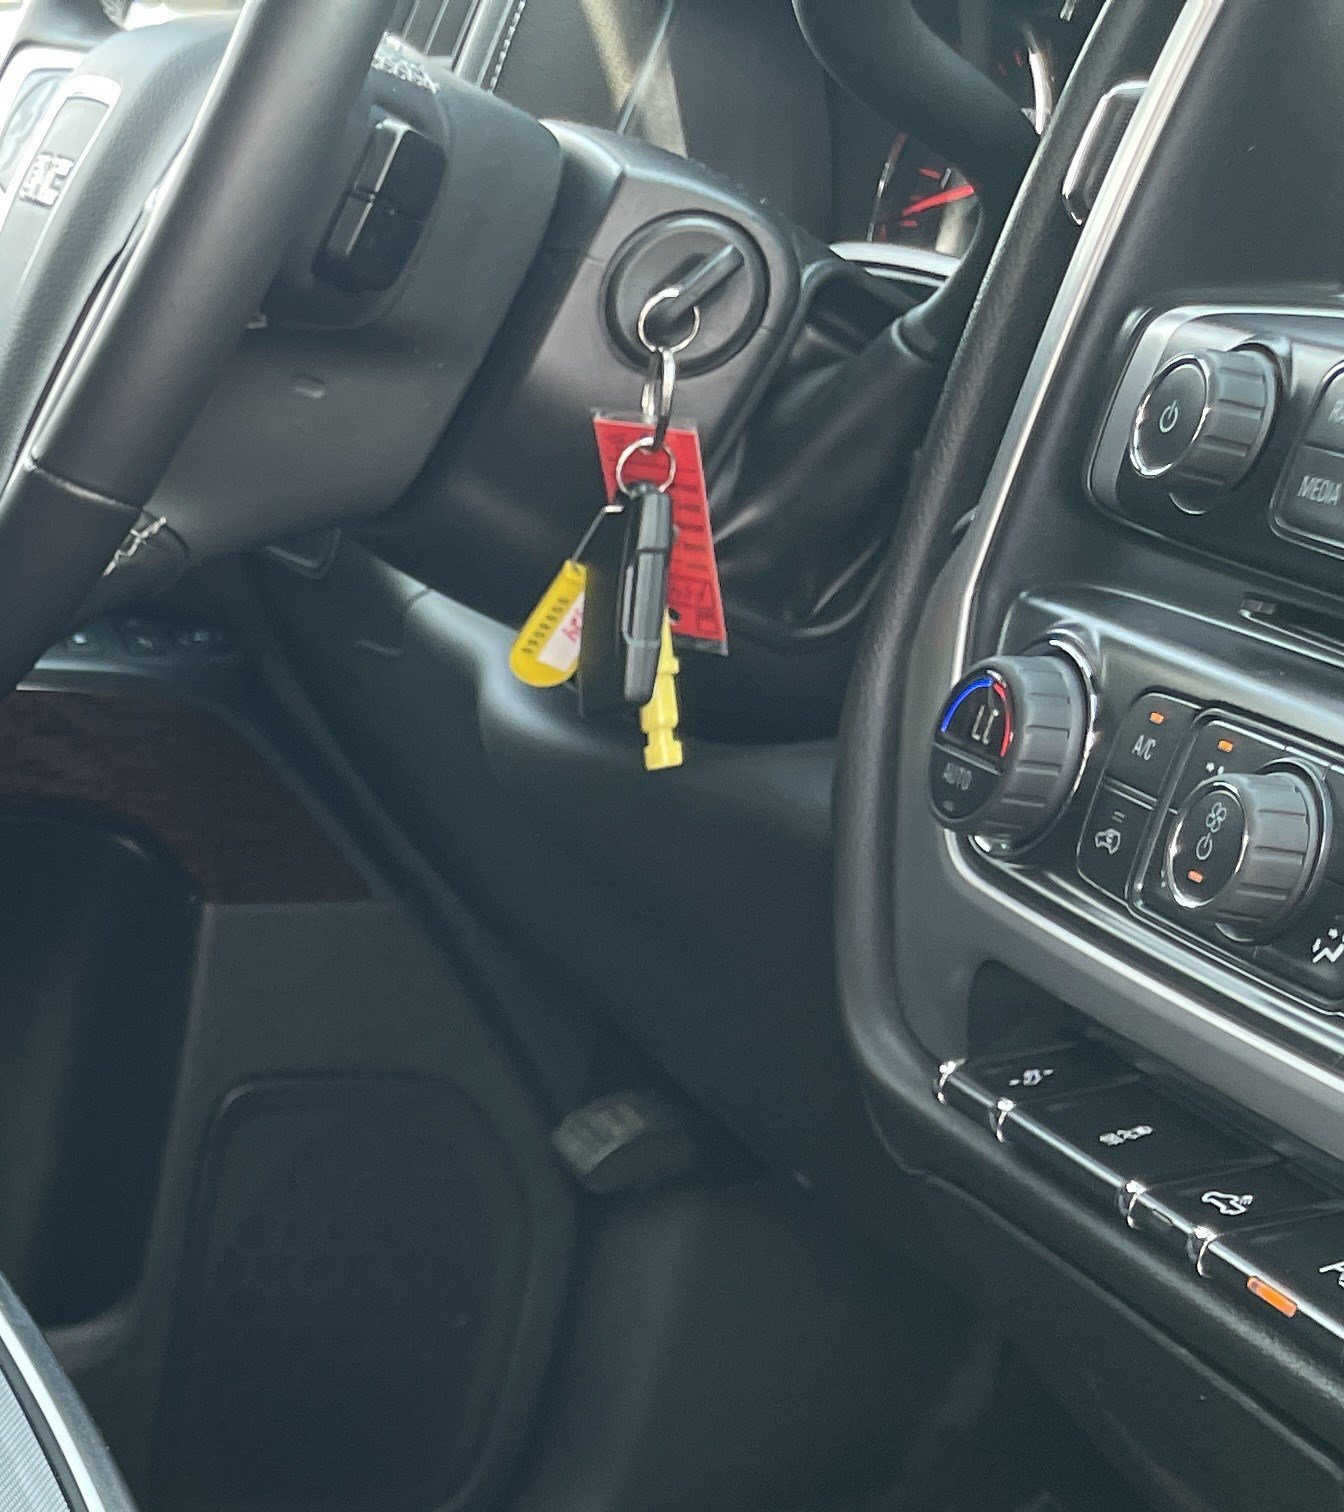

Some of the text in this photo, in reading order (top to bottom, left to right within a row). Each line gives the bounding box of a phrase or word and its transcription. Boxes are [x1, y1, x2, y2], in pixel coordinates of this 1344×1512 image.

[1296, 475, 1343, 506] MEDIA
[1131, 734, 1158, 762] A/C
[943, 762, 973, 791] AUTO
